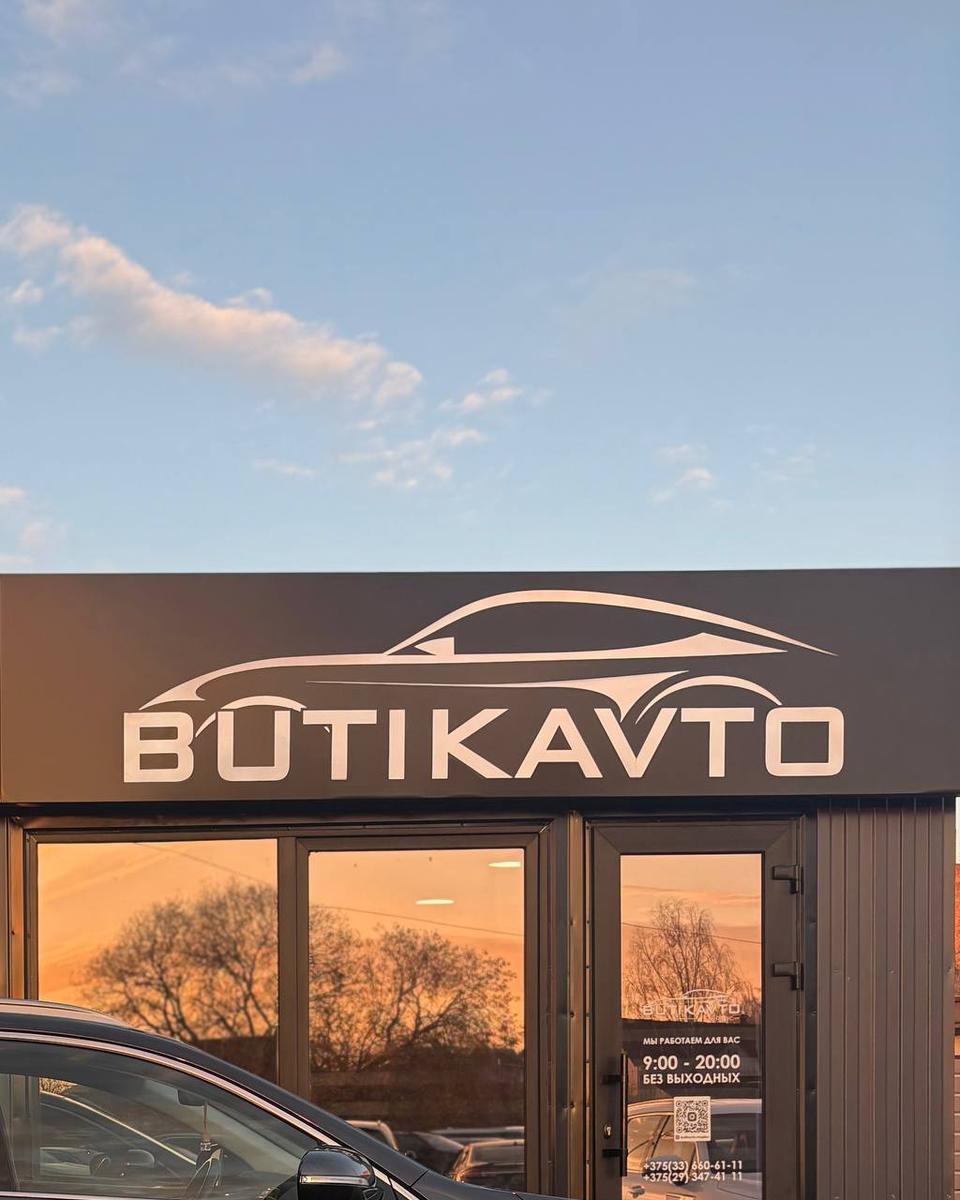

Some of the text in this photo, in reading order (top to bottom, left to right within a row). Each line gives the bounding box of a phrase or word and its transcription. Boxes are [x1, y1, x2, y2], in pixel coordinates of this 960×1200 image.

[124, 705, 845, 783] BUTIKAVTO
[643, 1003, 740, 1015] BUTIKAVTO
[643, 1036, 740, 1045] МЫ РАБОТАЕМ ДЛЯ ВАС
[643, 1055, 678, 1070] 9:00
[695, 1054, 740, 1069] 20:00
[643, 1072, 740, 1085] БЕЗ ВЫХОДНЫХ
[643, 1160, 743, 1173] +375(33) 660-61-11
[643, 1171, 743, 1184] +375(29) 347-4111
